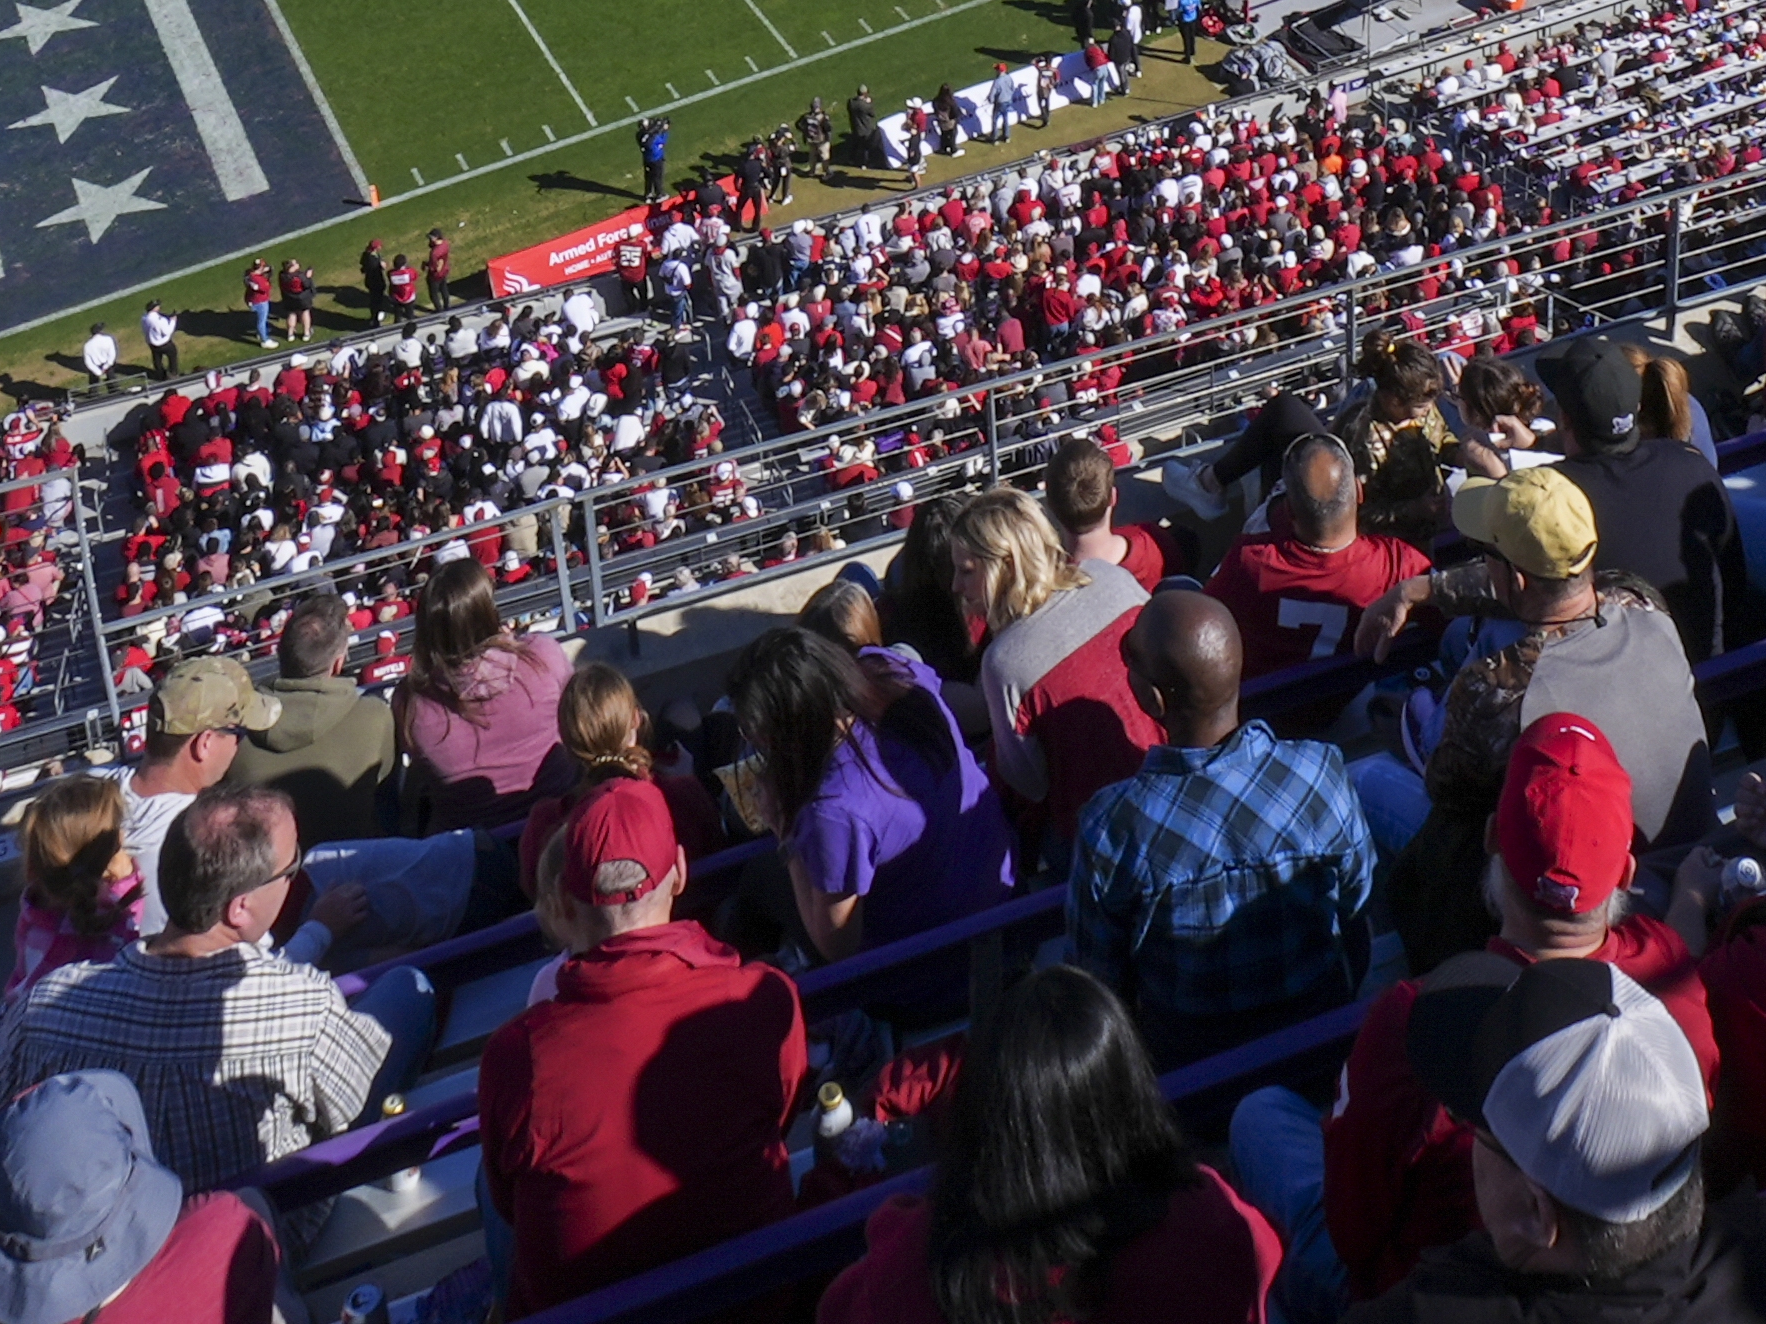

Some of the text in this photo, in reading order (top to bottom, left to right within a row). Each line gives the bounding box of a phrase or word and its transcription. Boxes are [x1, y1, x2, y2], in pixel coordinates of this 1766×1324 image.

[548, 236, 597, 267] Armed
[619, 250, 642, 268] 25
[563, 260, 591, 276] HOME
[1277, 598, 1349, 660] 7
